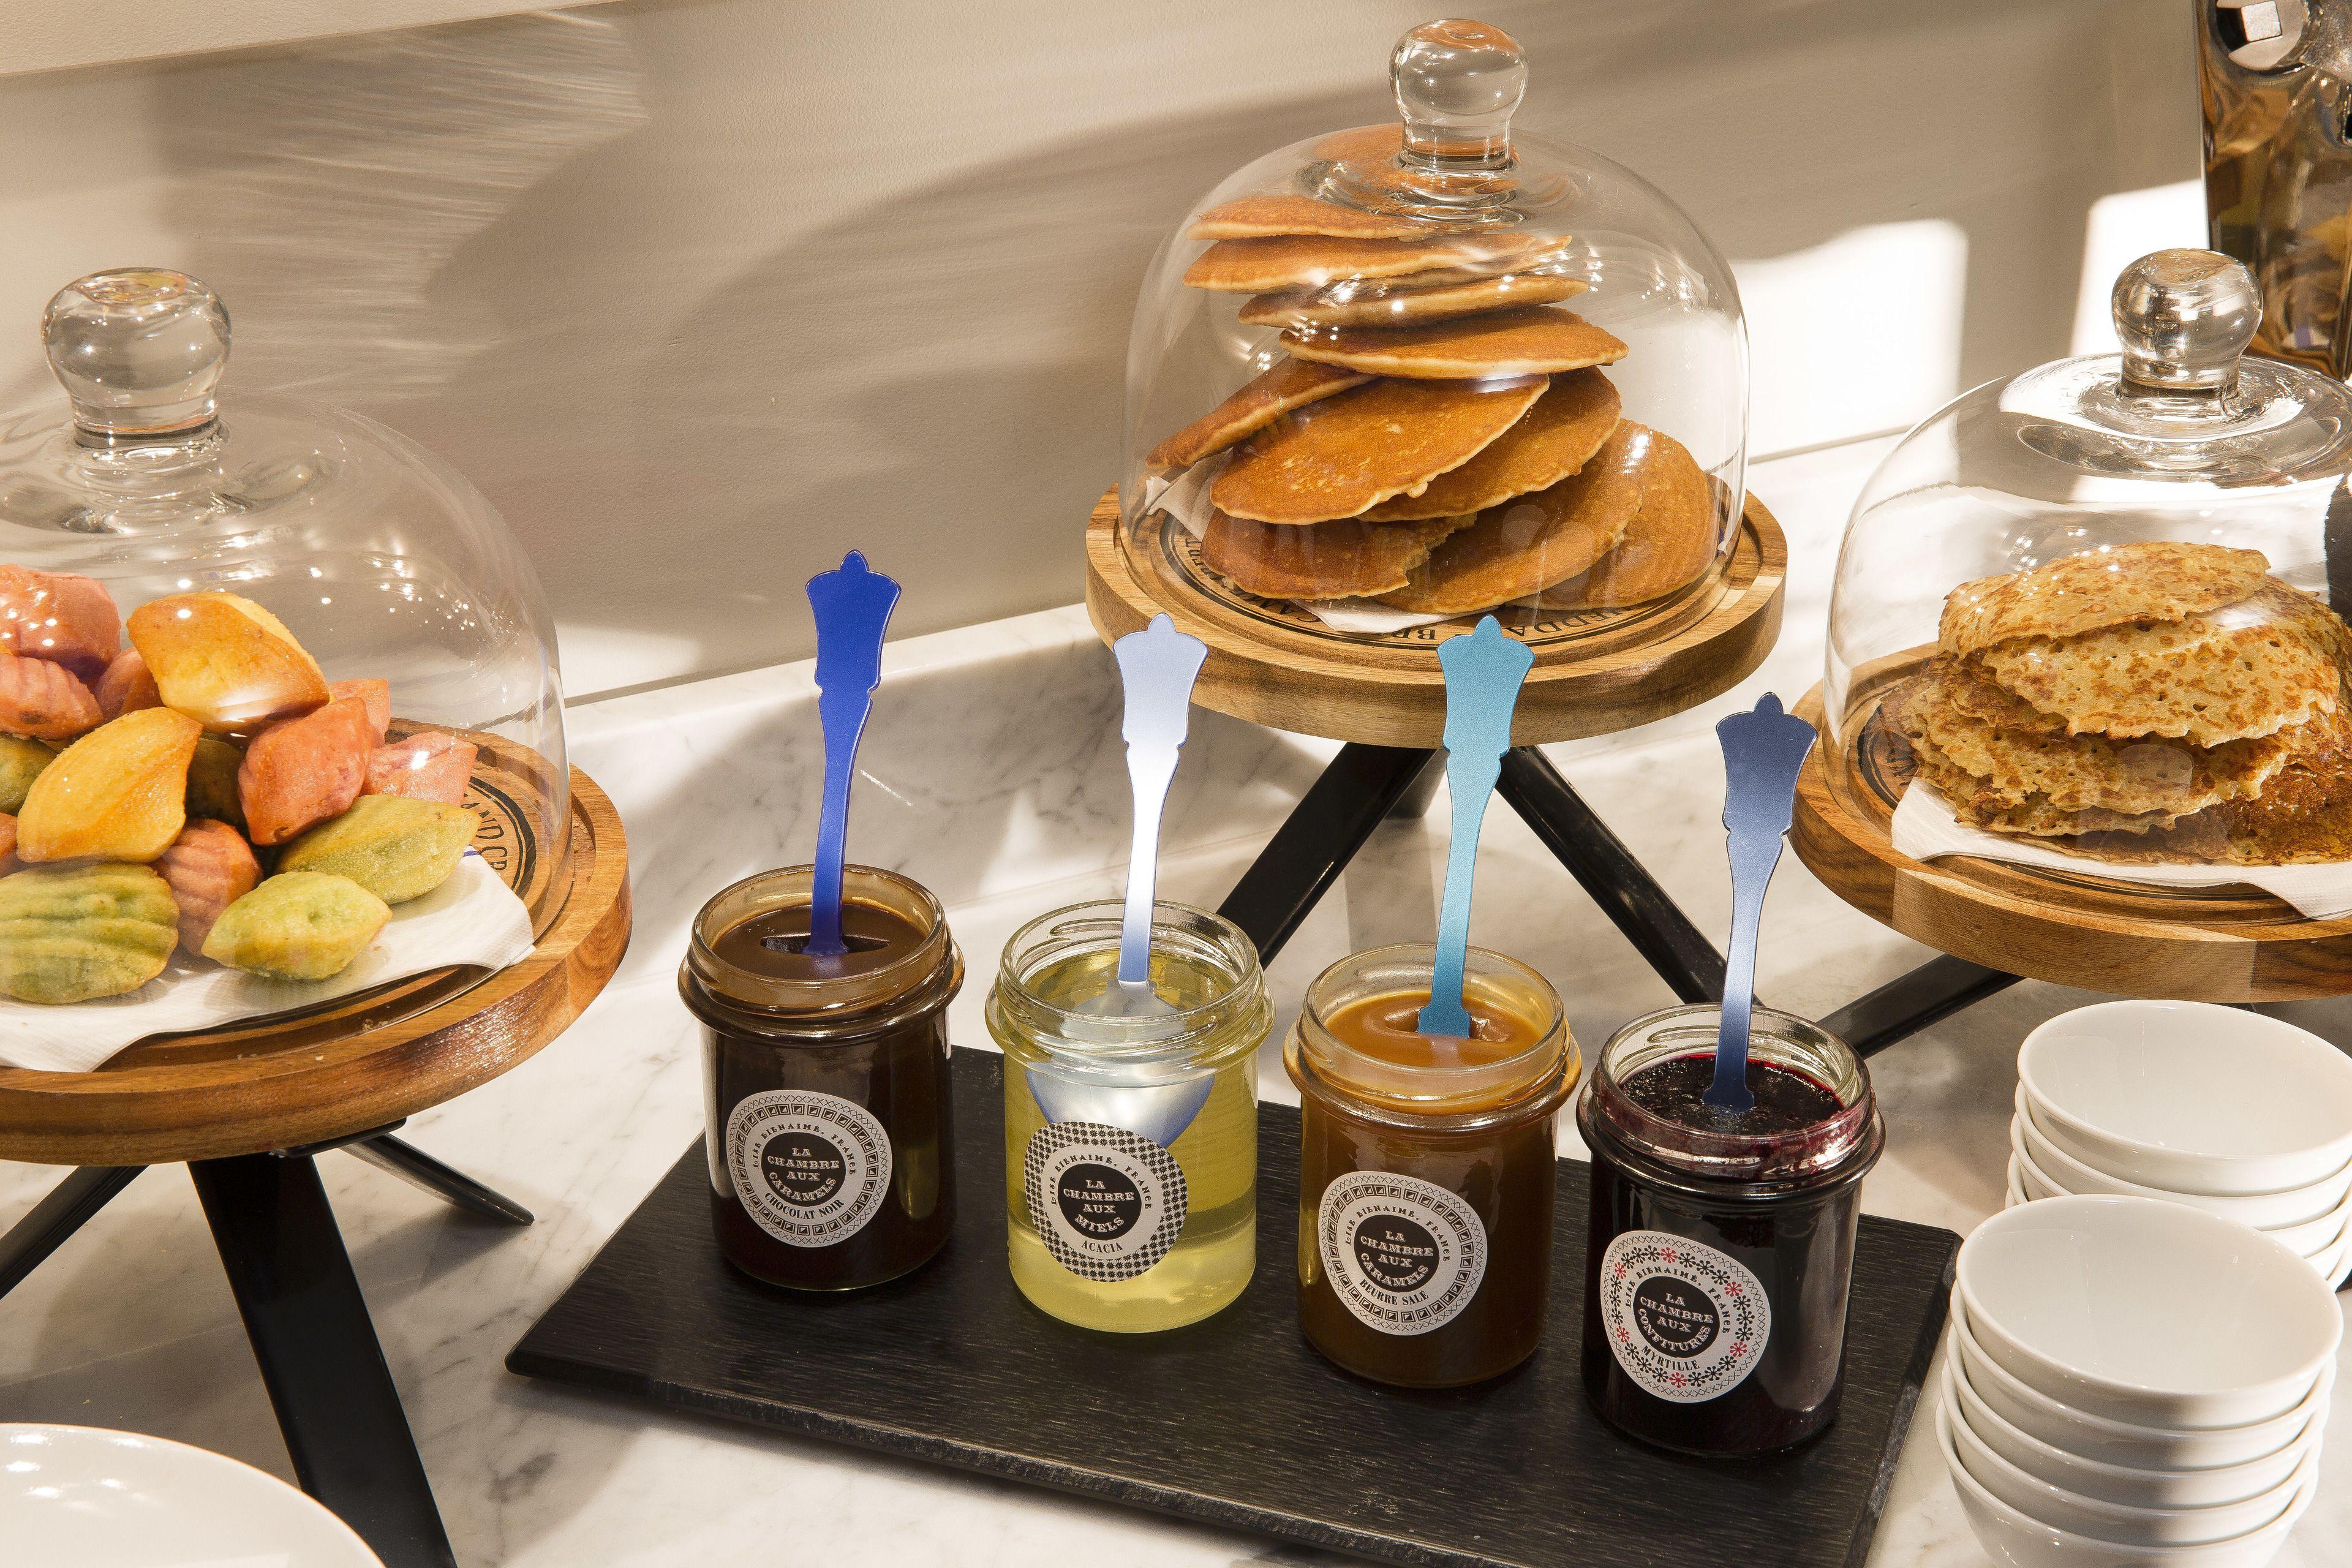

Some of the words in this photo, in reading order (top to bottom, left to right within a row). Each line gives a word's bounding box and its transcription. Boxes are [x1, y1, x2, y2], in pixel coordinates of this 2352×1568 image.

[753, 1142, 761, 1169] LISE
[831, 1134, 856, 1175] FRANCE
[767, 1155, 840, 1169] CHAMBRE
[792, 1147, 812, 1157] LA
[786, 1171, 820, 1181] AUX
[1086, 1180, 1106, 1189] LA
[769, 1172, 836, 1202] CARAMELS
[1063, 1188, 1134, 1202] CHAMBRE
[1124, 1166, 1152, 1209] FRANCE
[765, 1193, 815, 1219] CHOCOLAT
[818, 1199, 845, 1218] NOIR
[1082, 1204, 1117, 1214] AUX
[1074, 1214, 1125, 1233] MIELS
[1345, 1219, 1355, 1246] LISE
[1425, 1220, 1450, 1262] FRANCE
[1360, 1235, 1434, 1256] CHAMBRE
[1385, 1230, 1406, 1242] LA
[1082, 1240, 1124, 1253] ACACIA
[1360, 1253, 1429, 1287] CARAMELS
[1378, 1254, 1412, 1268] AUX
[1359, 1279, 1398, 1305] BEURRE
[1402, 1290, 1429, 1306] SALÉ
[1665, 1292, 1686, 1306] LA
[1625, 1280, 1636, 1309] LISE
[1708, 1287, 1731, 1334] FRANCE
[1640, 1295, 1714, 1324] CHAMBRE
[1638, 1308, 1711, 1351] CONFITURES
[1657, 1316, 1691, 1333] AUX
[1641, 1344, 1700, 1371] MYRTILLE
